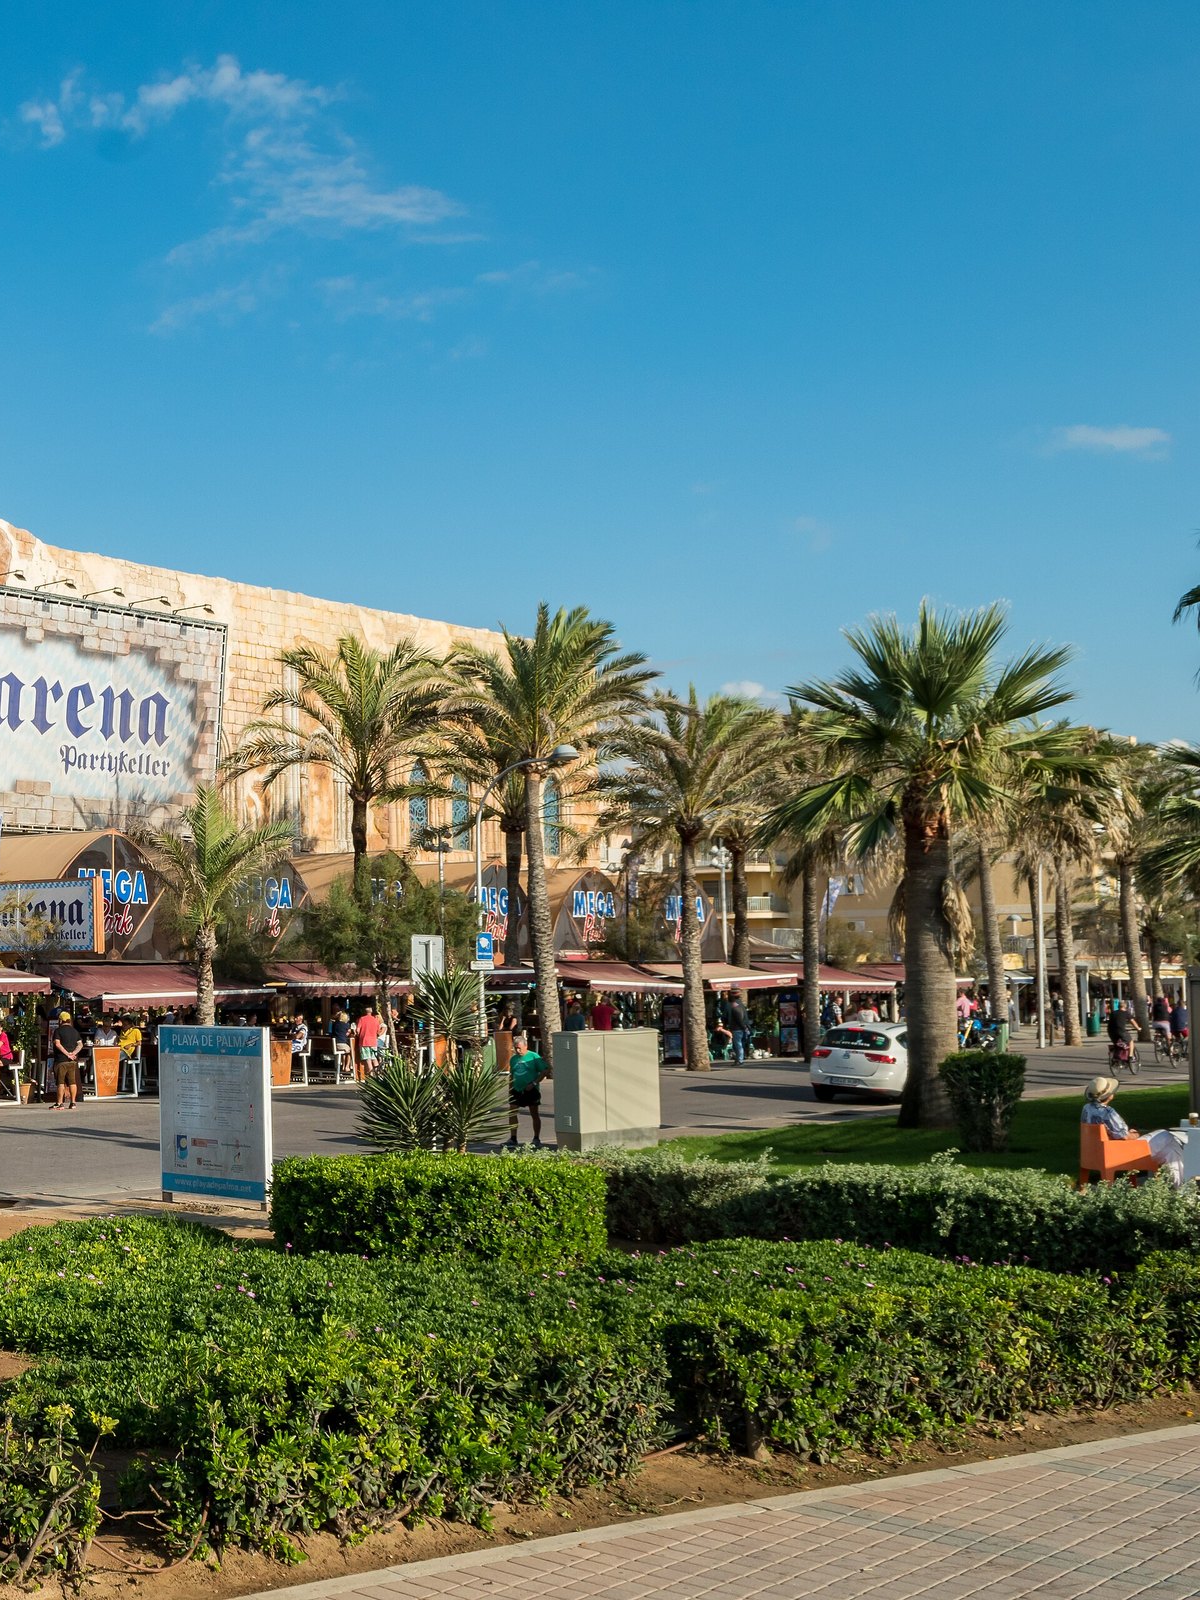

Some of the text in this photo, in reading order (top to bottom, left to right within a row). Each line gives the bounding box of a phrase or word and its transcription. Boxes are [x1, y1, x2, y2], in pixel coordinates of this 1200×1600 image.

[59, 744, 171, 778] Partykeller
[474, 886, 522, 916] MEG
[573, 890, 616, 918] MEGA
[171, 1033, 200, 1046] PLAYA
[201, 1034, 214, 1047] DE
